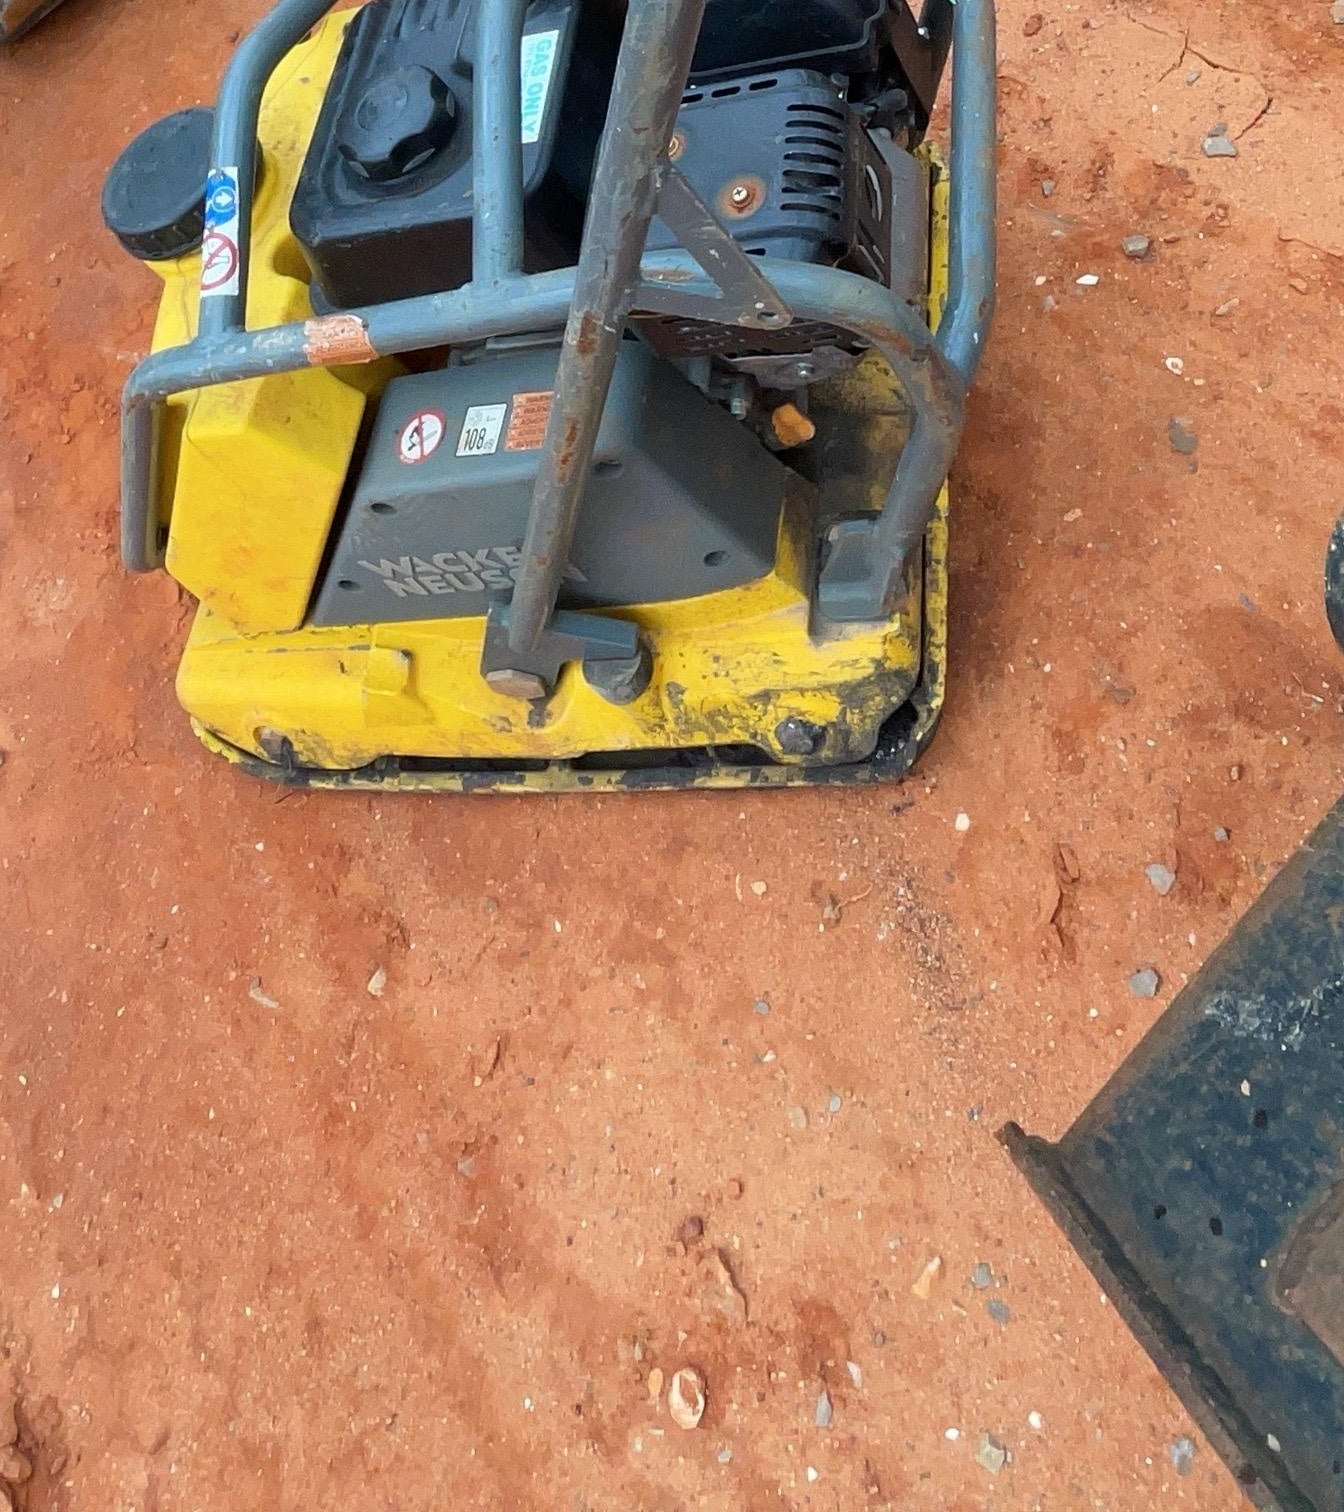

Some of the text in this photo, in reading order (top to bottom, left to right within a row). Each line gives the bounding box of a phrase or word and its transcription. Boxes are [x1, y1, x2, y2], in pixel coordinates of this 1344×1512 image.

[530, 38, 552, 77] GAS
[523, 82, 544, 133] ONLY
[463, 427, 487, 451] 108
[358, 546, 522, 578] WACKE
